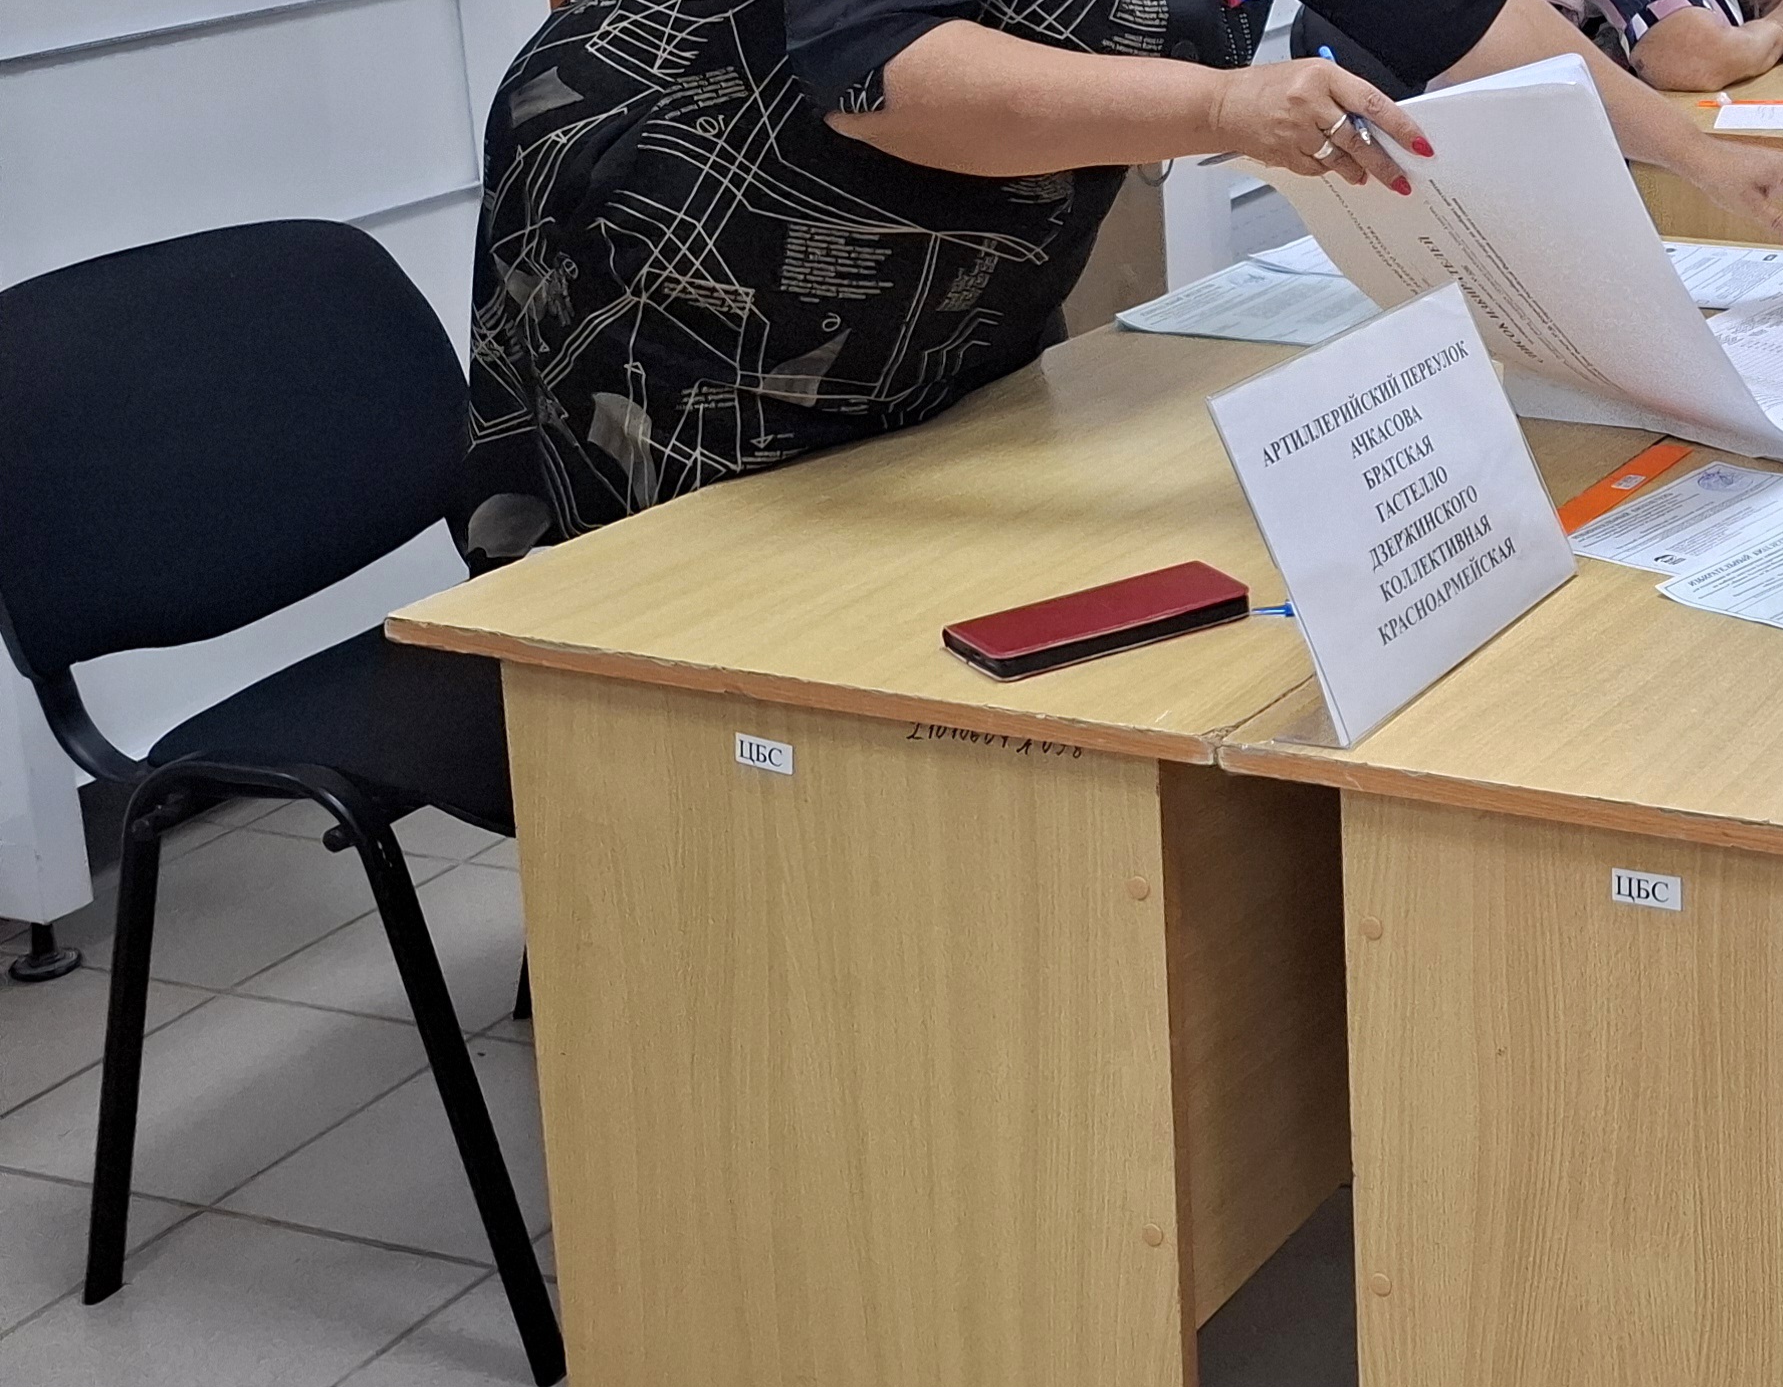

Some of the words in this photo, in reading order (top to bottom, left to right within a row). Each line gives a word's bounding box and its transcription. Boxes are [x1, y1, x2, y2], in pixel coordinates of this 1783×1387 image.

[1261, 372, 1401, 467] АРТИЛЛЕРИЙСКИЙ
[1400, 338, 1470, 391] ПЕРЕУЛОК
[1350, 405, 1424, 460] АЧКАСОВА
[1363, 434, 1436, 491] БРАТСКАЯ
[1375, 465, 1449, 524] ГАСТЕЛЛО
[1369, 484, 1479, 572] ДЗЕРЖИНСКОГО
[1380, 514, 1494, 602] КОЛЛЕКТИВНАЯ
[1376, 535, 1517, 646] КРАСНОАРМЕЙСКАЯ
[739, 739, 783, 767] ЦБС
[1615, 874, 1669, 903] ЦБС
